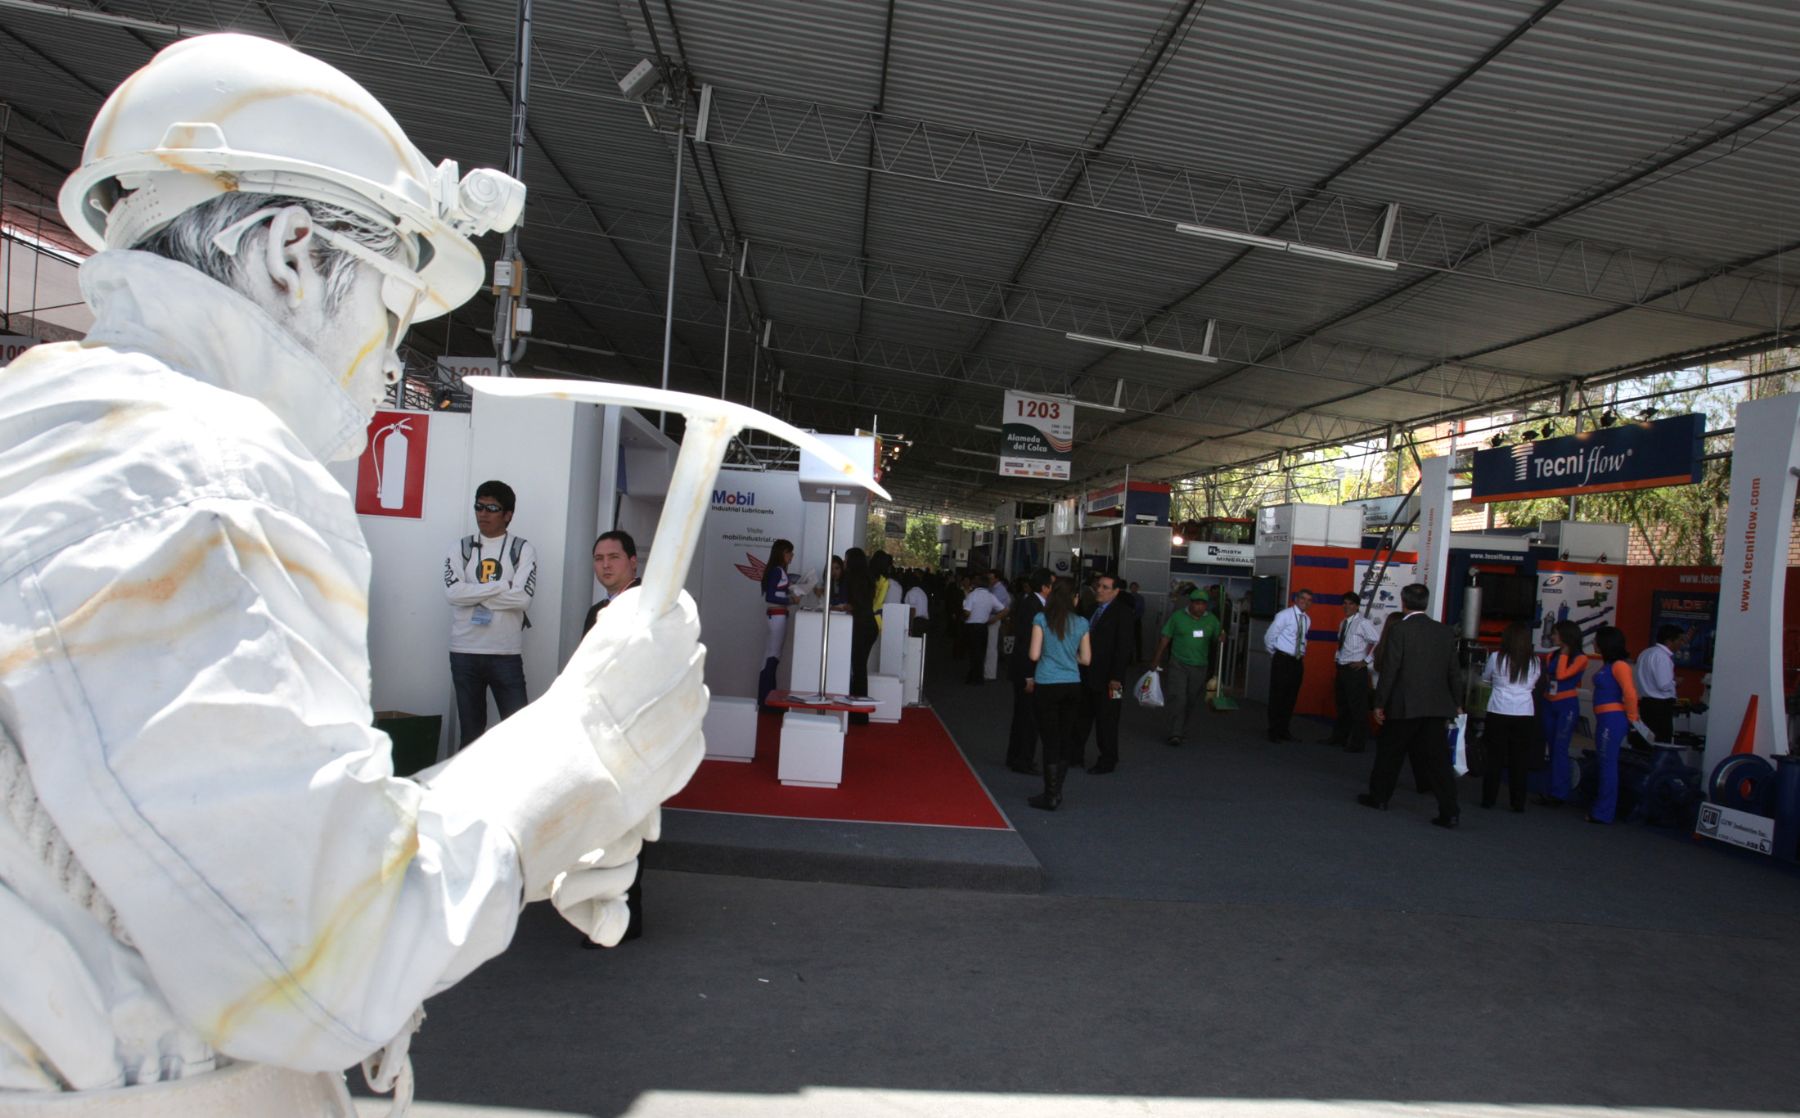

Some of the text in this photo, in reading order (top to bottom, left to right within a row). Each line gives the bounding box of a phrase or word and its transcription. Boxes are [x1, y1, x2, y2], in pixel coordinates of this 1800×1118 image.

[1017, 400, 1060, 419] 1203
[1007, 433, 1040, 443] Alameda
[1013, 442, 1047, 452] del Colca
[711, 490, 755, 506] Mobil
[741, 507, 774, 515] Lubricants
[722, 534, 777, 543] mobilindustrial.c
[1741, 477, 1760, 612] www.tecniflow.com
[1680, 574, 1720, 584] www.tecn
